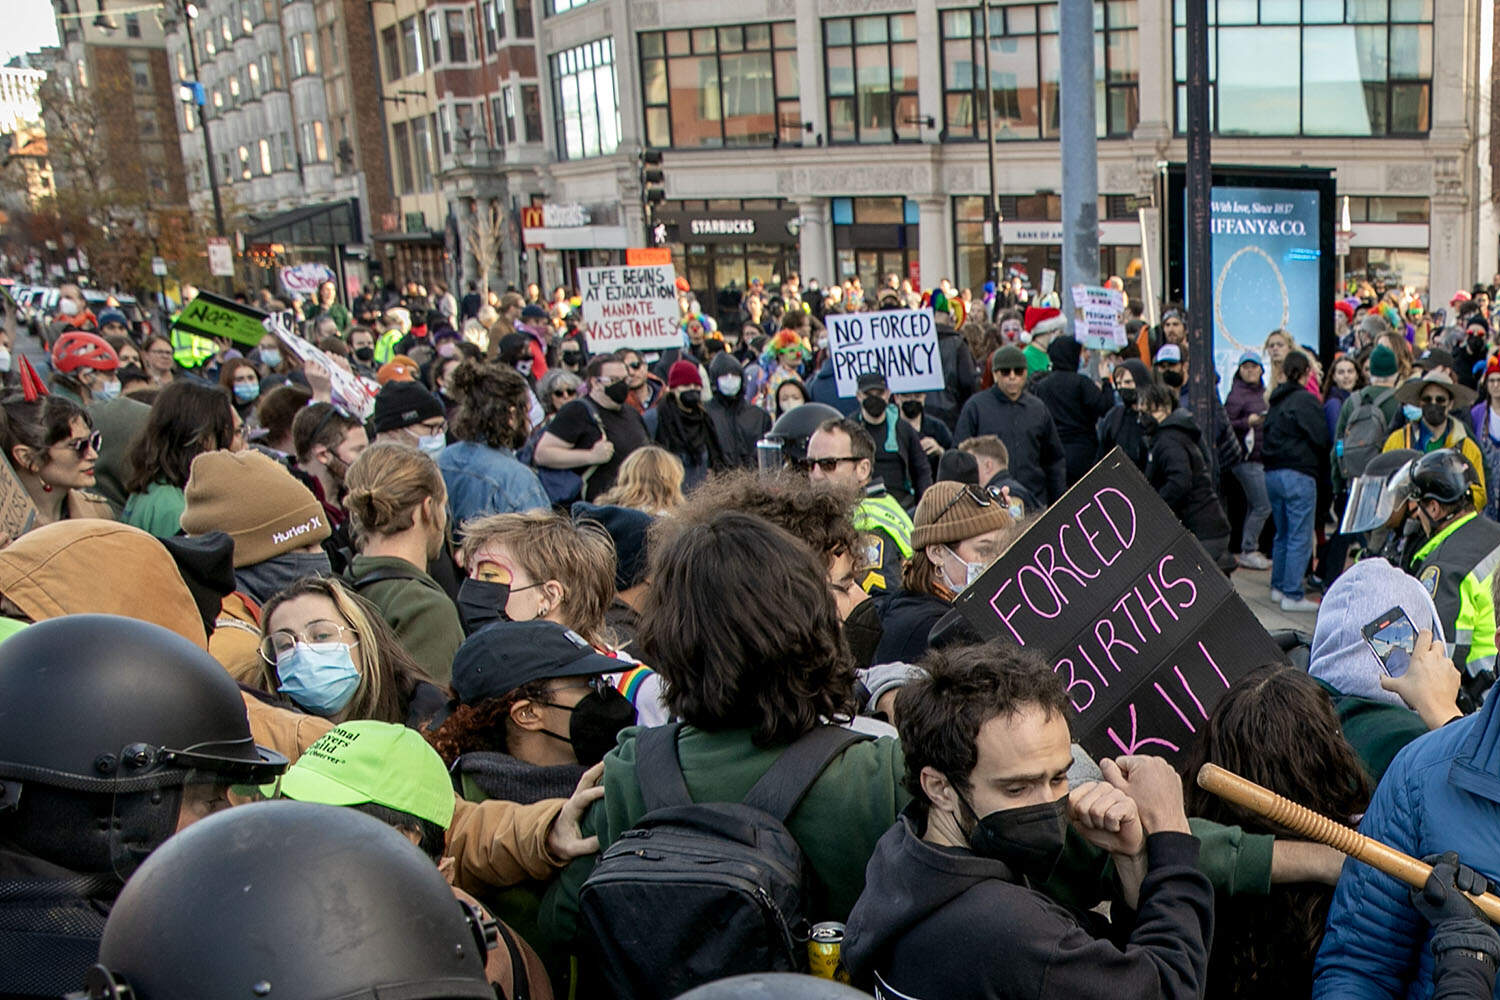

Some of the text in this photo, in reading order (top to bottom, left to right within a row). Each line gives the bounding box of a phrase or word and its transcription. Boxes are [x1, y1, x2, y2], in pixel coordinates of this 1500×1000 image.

[691, 218, 755, 234] STARBUCKS
[1211, 218, 1306, 236] IFFANY&CO.
[588, 268, 665, 285] LIFE BEGINS
[585, 283, 675, 301] AT EJACULATION
[602, 301, 656, 317] MANDATE
[585, 318, 680, 340] VASECTOMIES
[834, 313, 931, 343] NO FORCED
[834, 342, 936, 380] PREGNANCY
[272, 521, 311, 545] Hurley
[988, 487, 1137, 647] FORCED
[1053, 554, 1198, 713] BIRTHS
